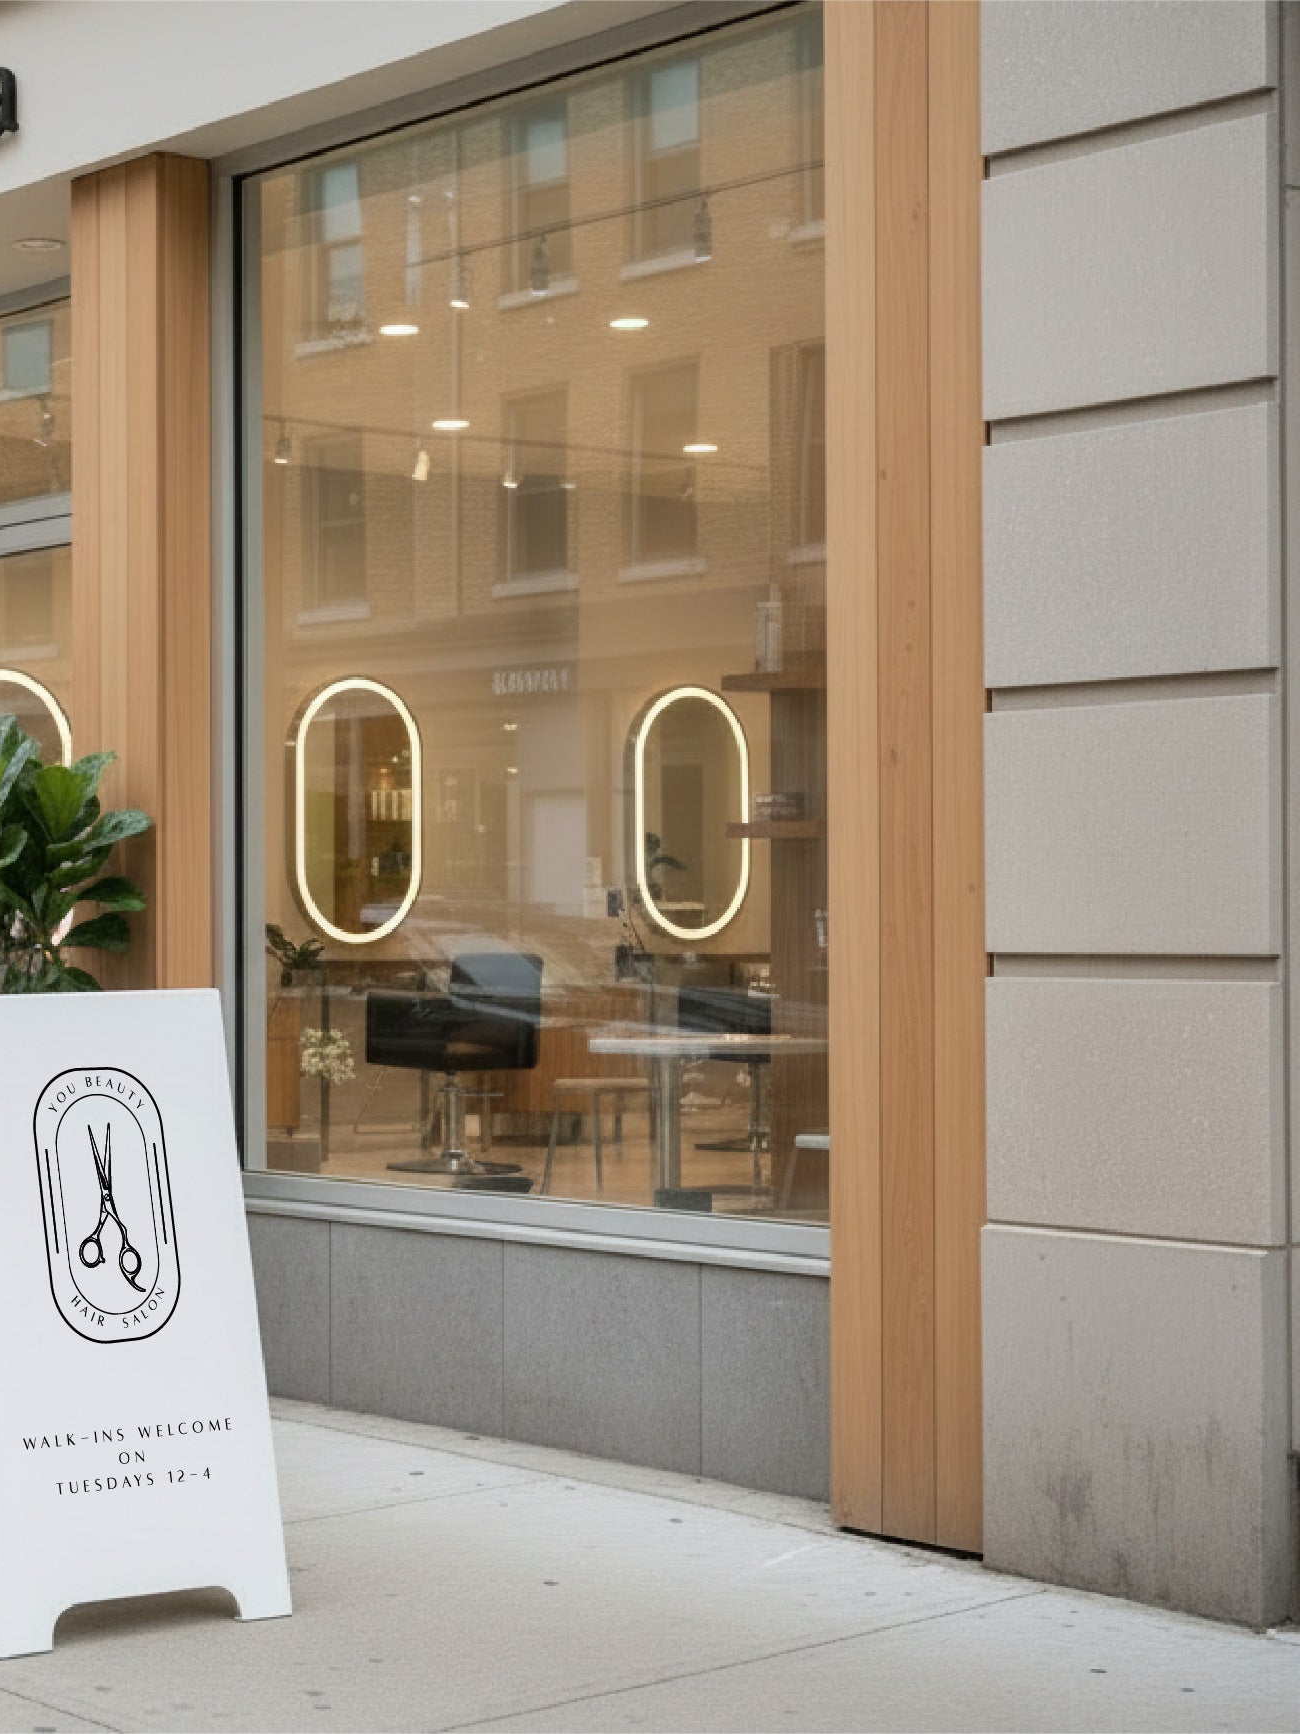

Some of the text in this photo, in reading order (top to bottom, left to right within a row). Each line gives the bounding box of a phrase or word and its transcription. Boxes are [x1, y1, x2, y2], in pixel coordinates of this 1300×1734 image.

[47, 1076, 145, 1113] YOU BEAUTY
[70, 1287, 165, 1329] HAIR SALON
[22, 1417, 233, 1451] WALK-INS WELCOME
[118, 1450, 146, 1465] ON
[55, 1466, 212, 1495] TUESDAYS 12-4
